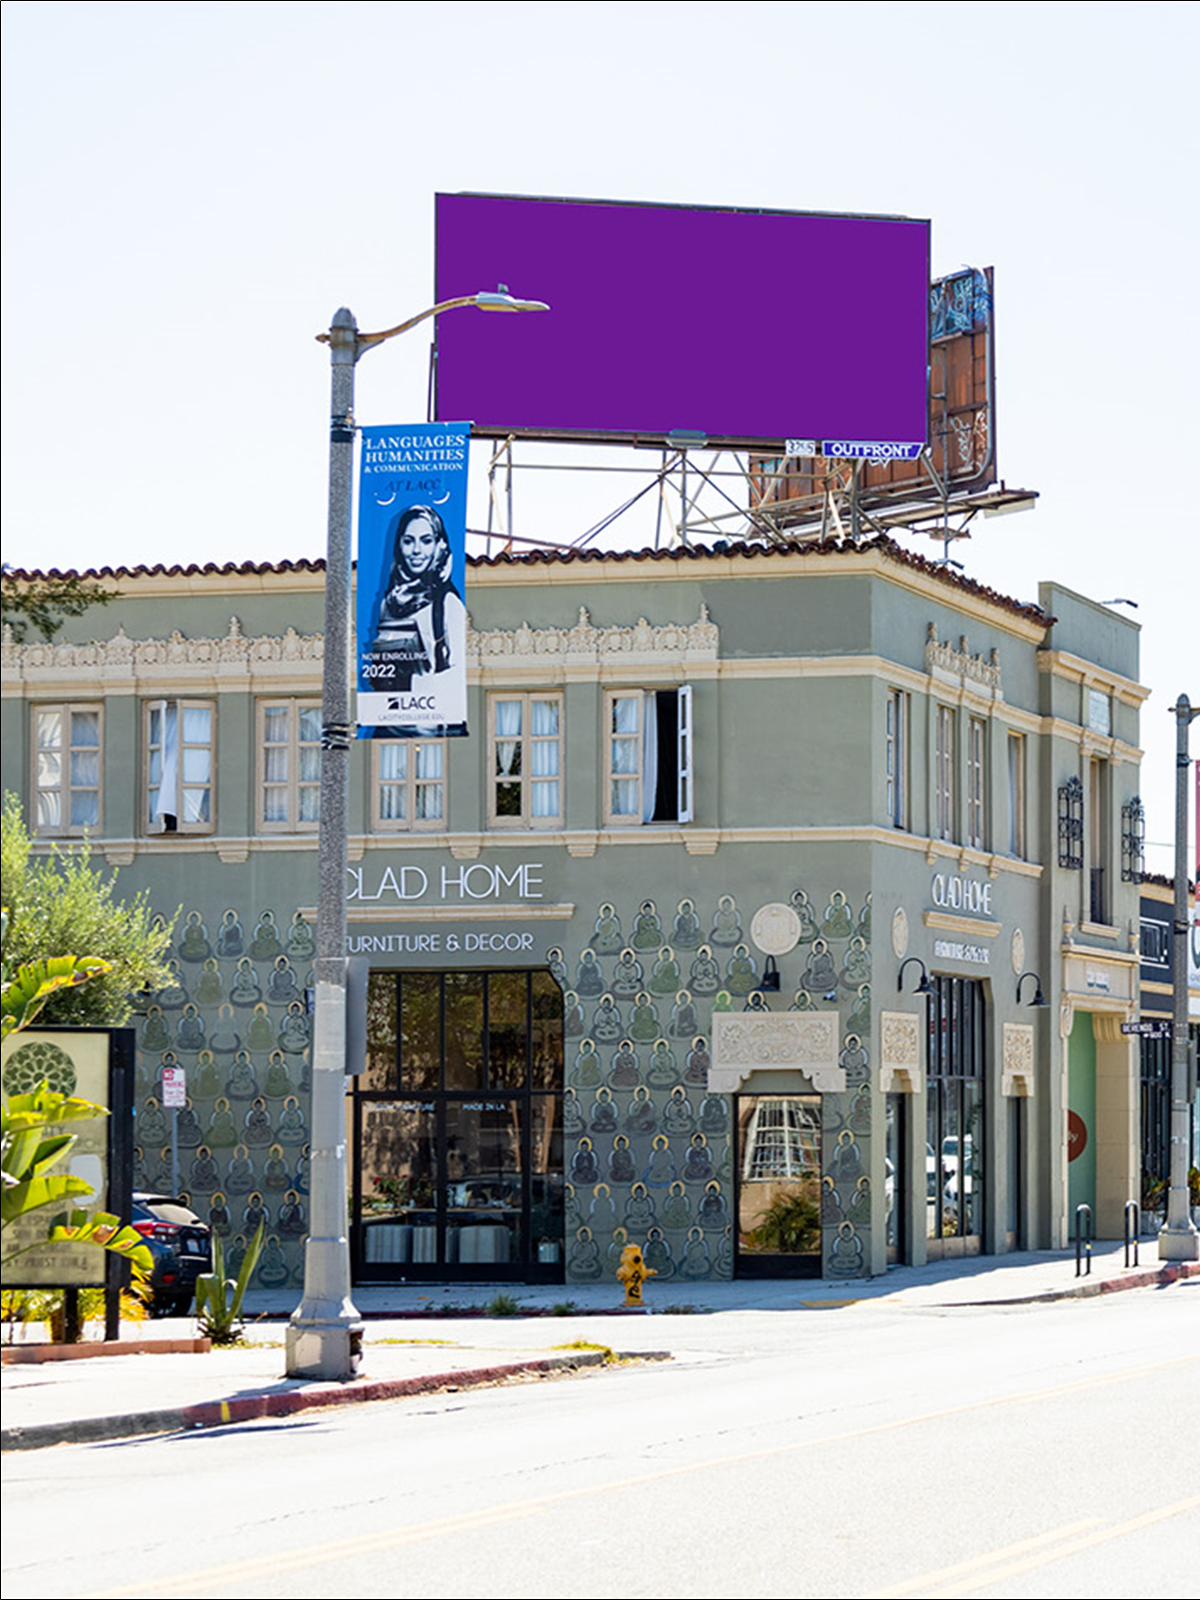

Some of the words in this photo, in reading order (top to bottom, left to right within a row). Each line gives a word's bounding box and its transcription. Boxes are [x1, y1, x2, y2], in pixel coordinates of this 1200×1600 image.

[366, 434, 466, 449] LANGUAGES
[365, 449, 465, 463] HUMANITIES
[831, 443, 913, 457] OUTFRONT
[364, 465, 372, 473] &
[374, 462, 463, 473] COMMUNICATION
[384, 480, 403, 491] AT
[405, 478, 441, 491] LACC
[361, 653, 380, 661] NOW
[382, 652, 427, 661] ENROLLING
[362, 664, 396, 678] 2022
[401, 696, 435, 710] LACC
[441, 864, 543, 898] HOME
[932, 874, 961, 909] CLAD
[346, 934, 441, 953] URNITURE
[446, 934, 460, 952] &
[465, 933, 533, 951] DECOR
